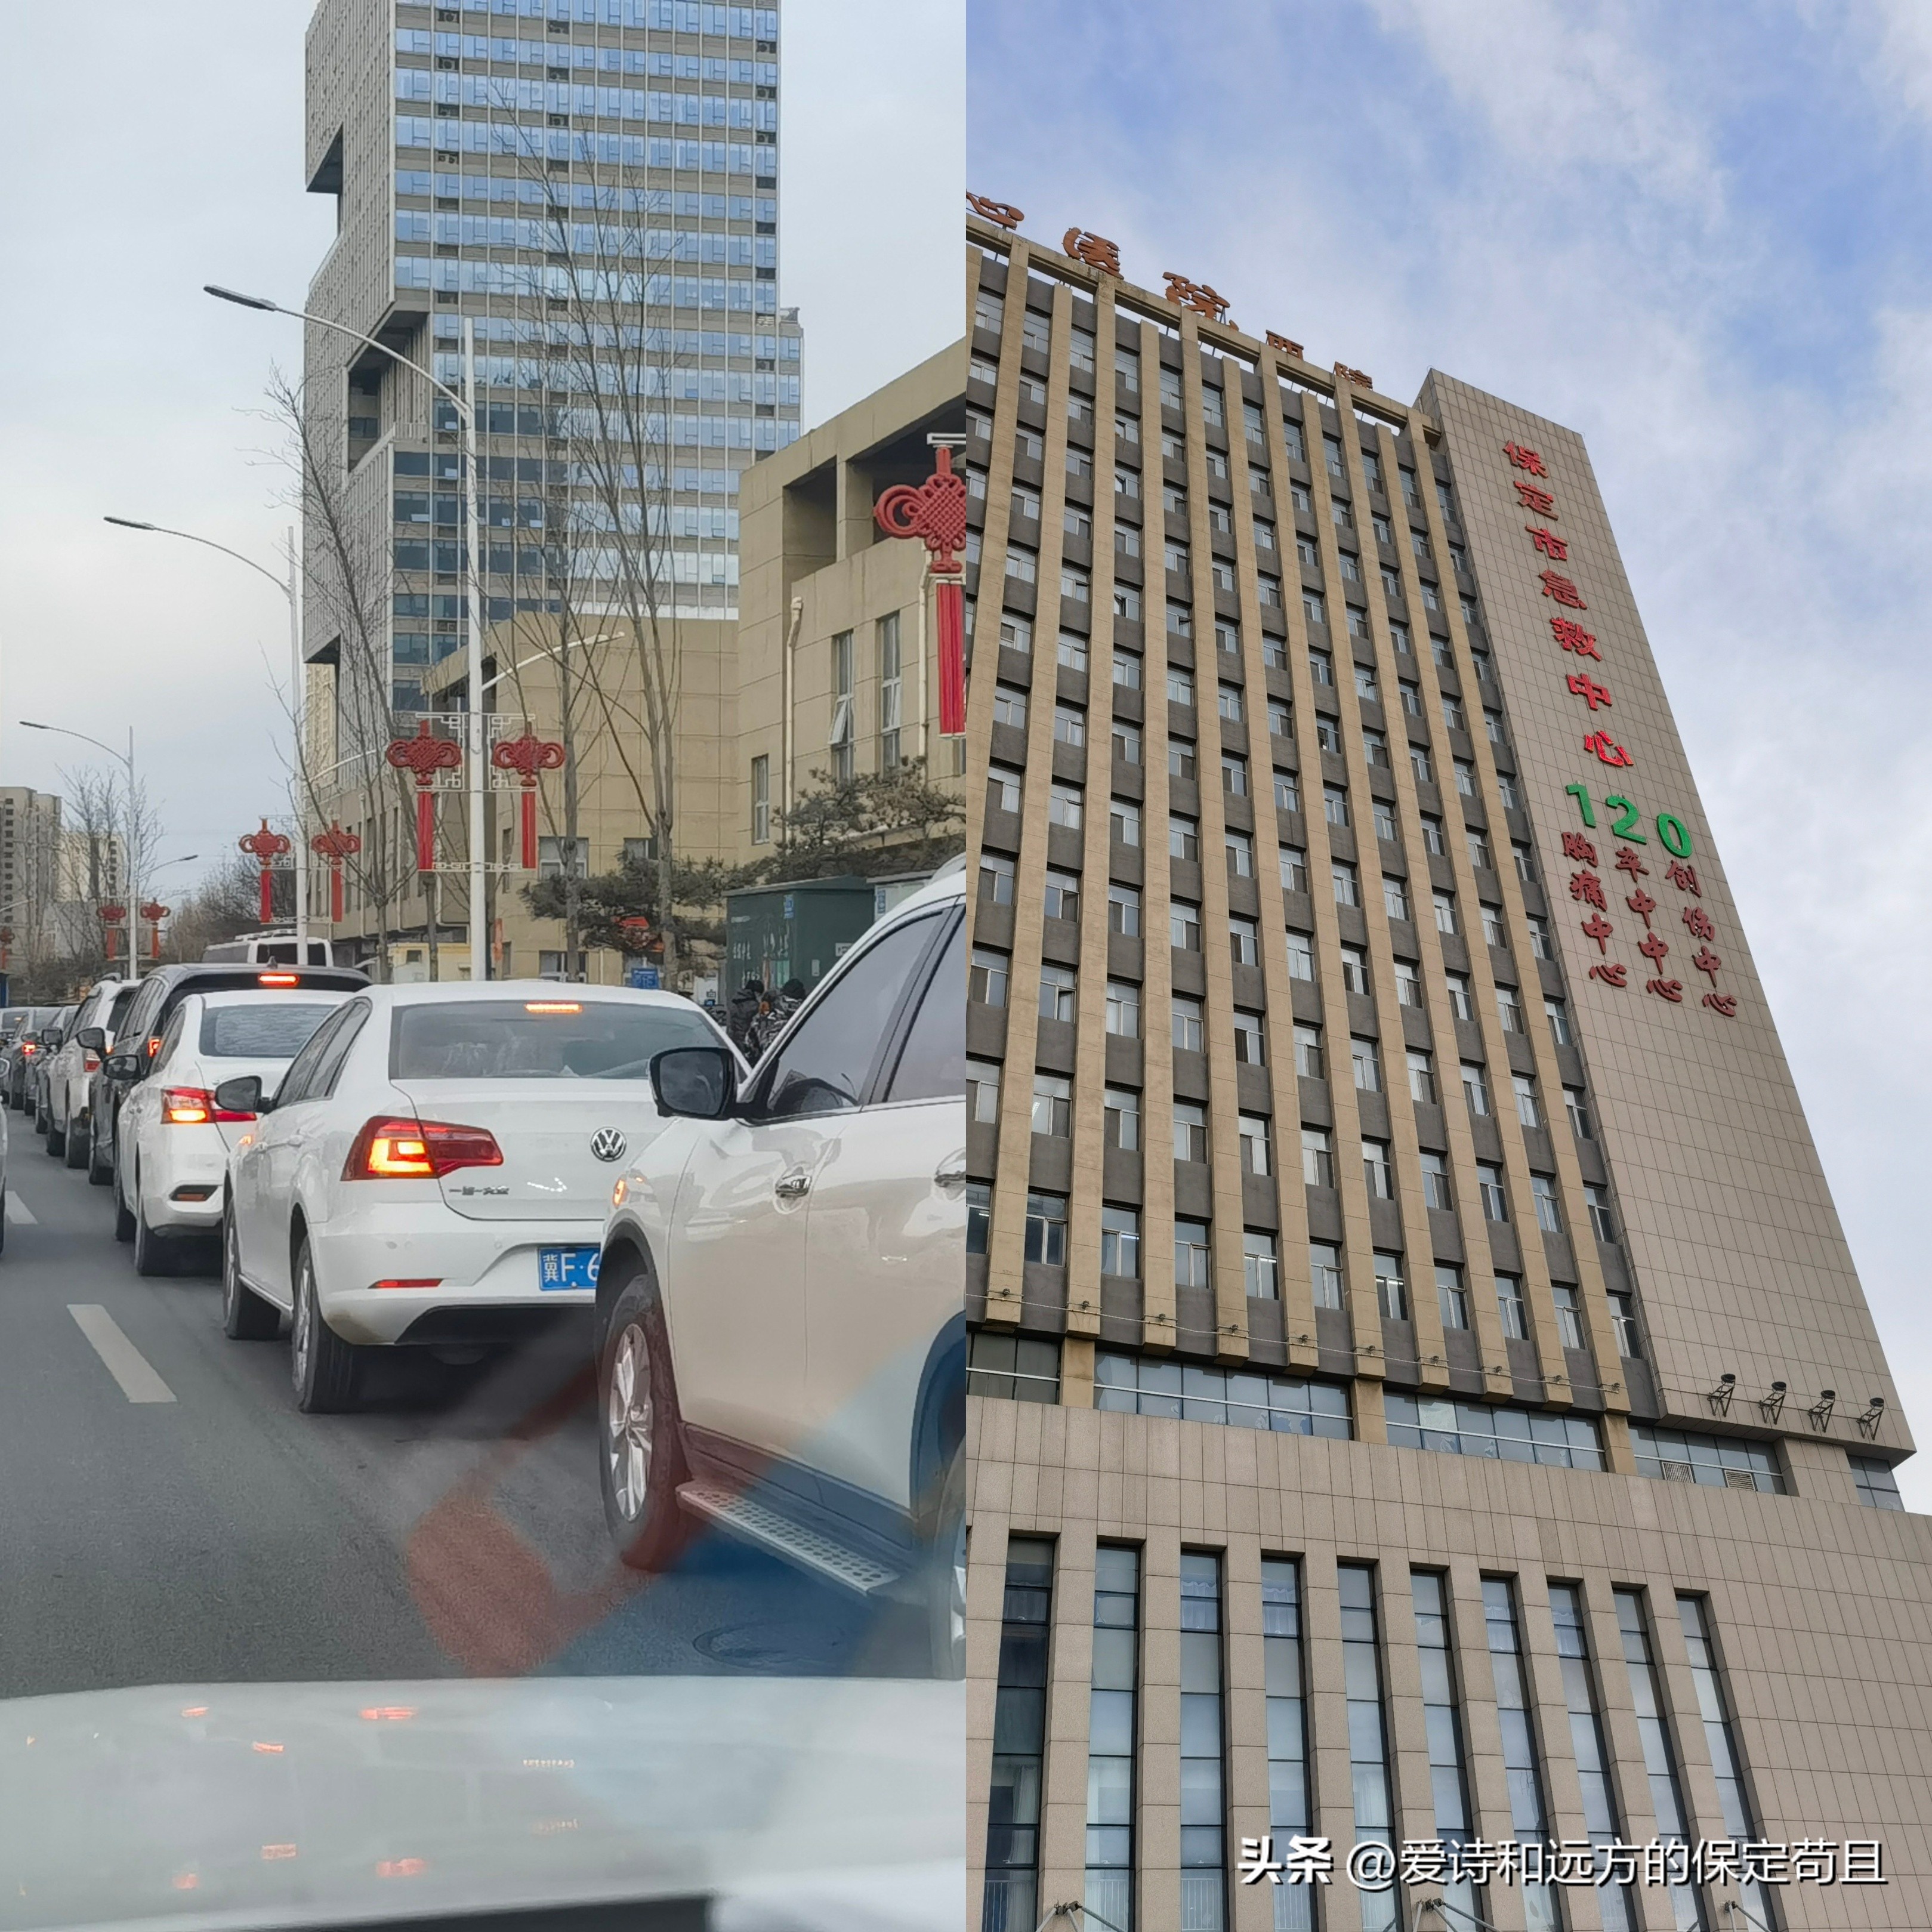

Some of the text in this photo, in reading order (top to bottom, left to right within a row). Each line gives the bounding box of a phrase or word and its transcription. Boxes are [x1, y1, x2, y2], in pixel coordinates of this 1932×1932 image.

[1502, 440, 1634, 767] 保定市急救中心
[1566, 782, 1693, 858] 120
[1561, 831, 1628, 987] 胸痛中心
[1615, 846, 1683, 1003] 卒中中心
[1665, 860, 1737, 1017] 创伤中心
